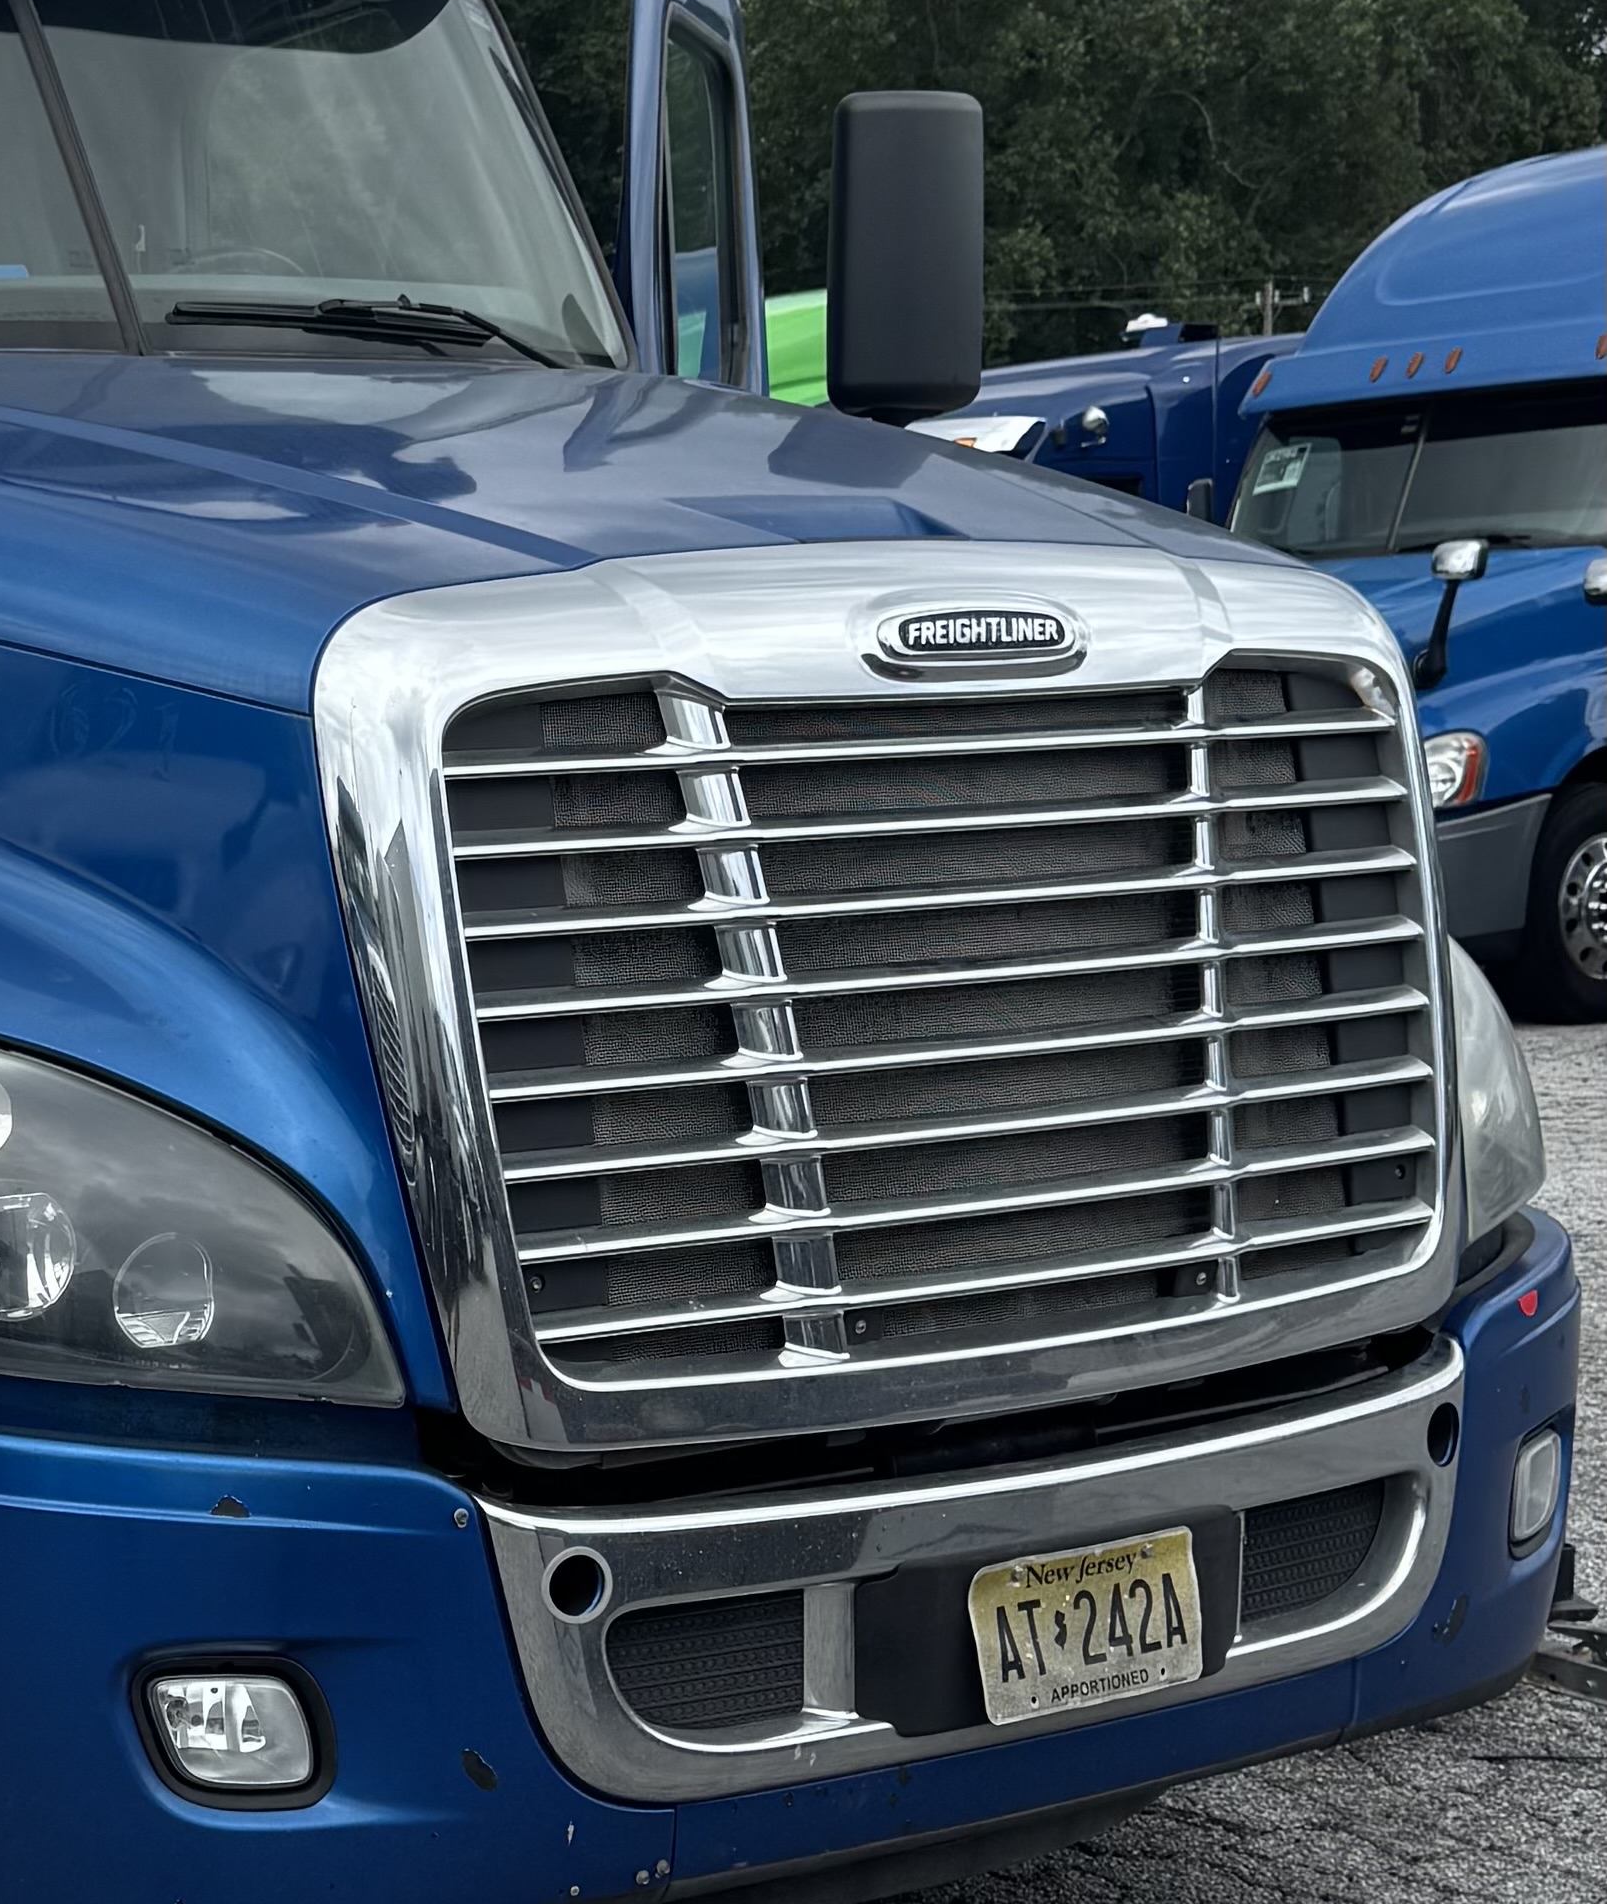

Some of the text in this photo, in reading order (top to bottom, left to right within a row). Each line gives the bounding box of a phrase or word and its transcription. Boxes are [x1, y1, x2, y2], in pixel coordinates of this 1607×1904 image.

[908, 616, 1059, 645] FREIGHTLINER
[1026, 1552, 1137, 1588] New Jersey
[1050, 1669, 1149, 1704] APPORTIONED
